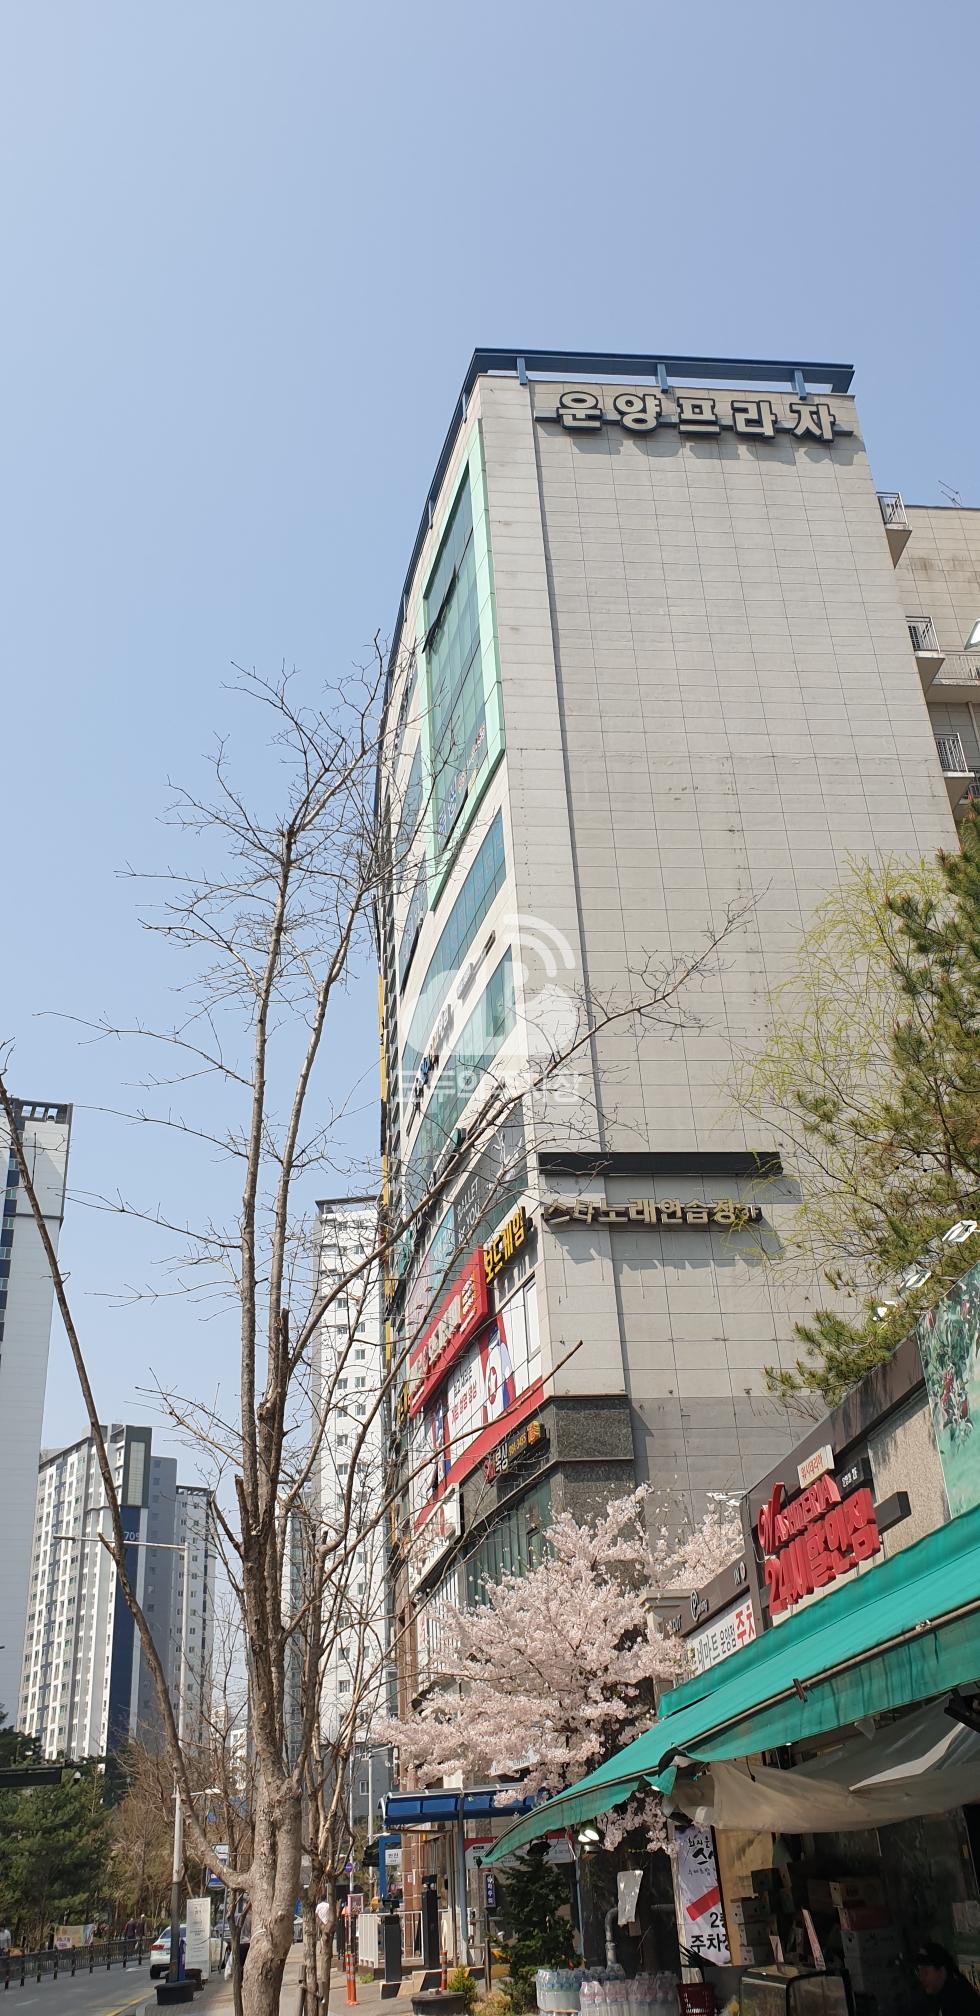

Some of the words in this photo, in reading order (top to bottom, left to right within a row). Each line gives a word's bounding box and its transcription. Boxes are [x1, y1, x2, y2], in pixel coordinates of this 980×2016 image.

[557, 390, 836, 442] 운양프라자
[549, 1198, 736, 1224] 스타노래연습장
[484, 1206, 525, 1283] 보드게임
